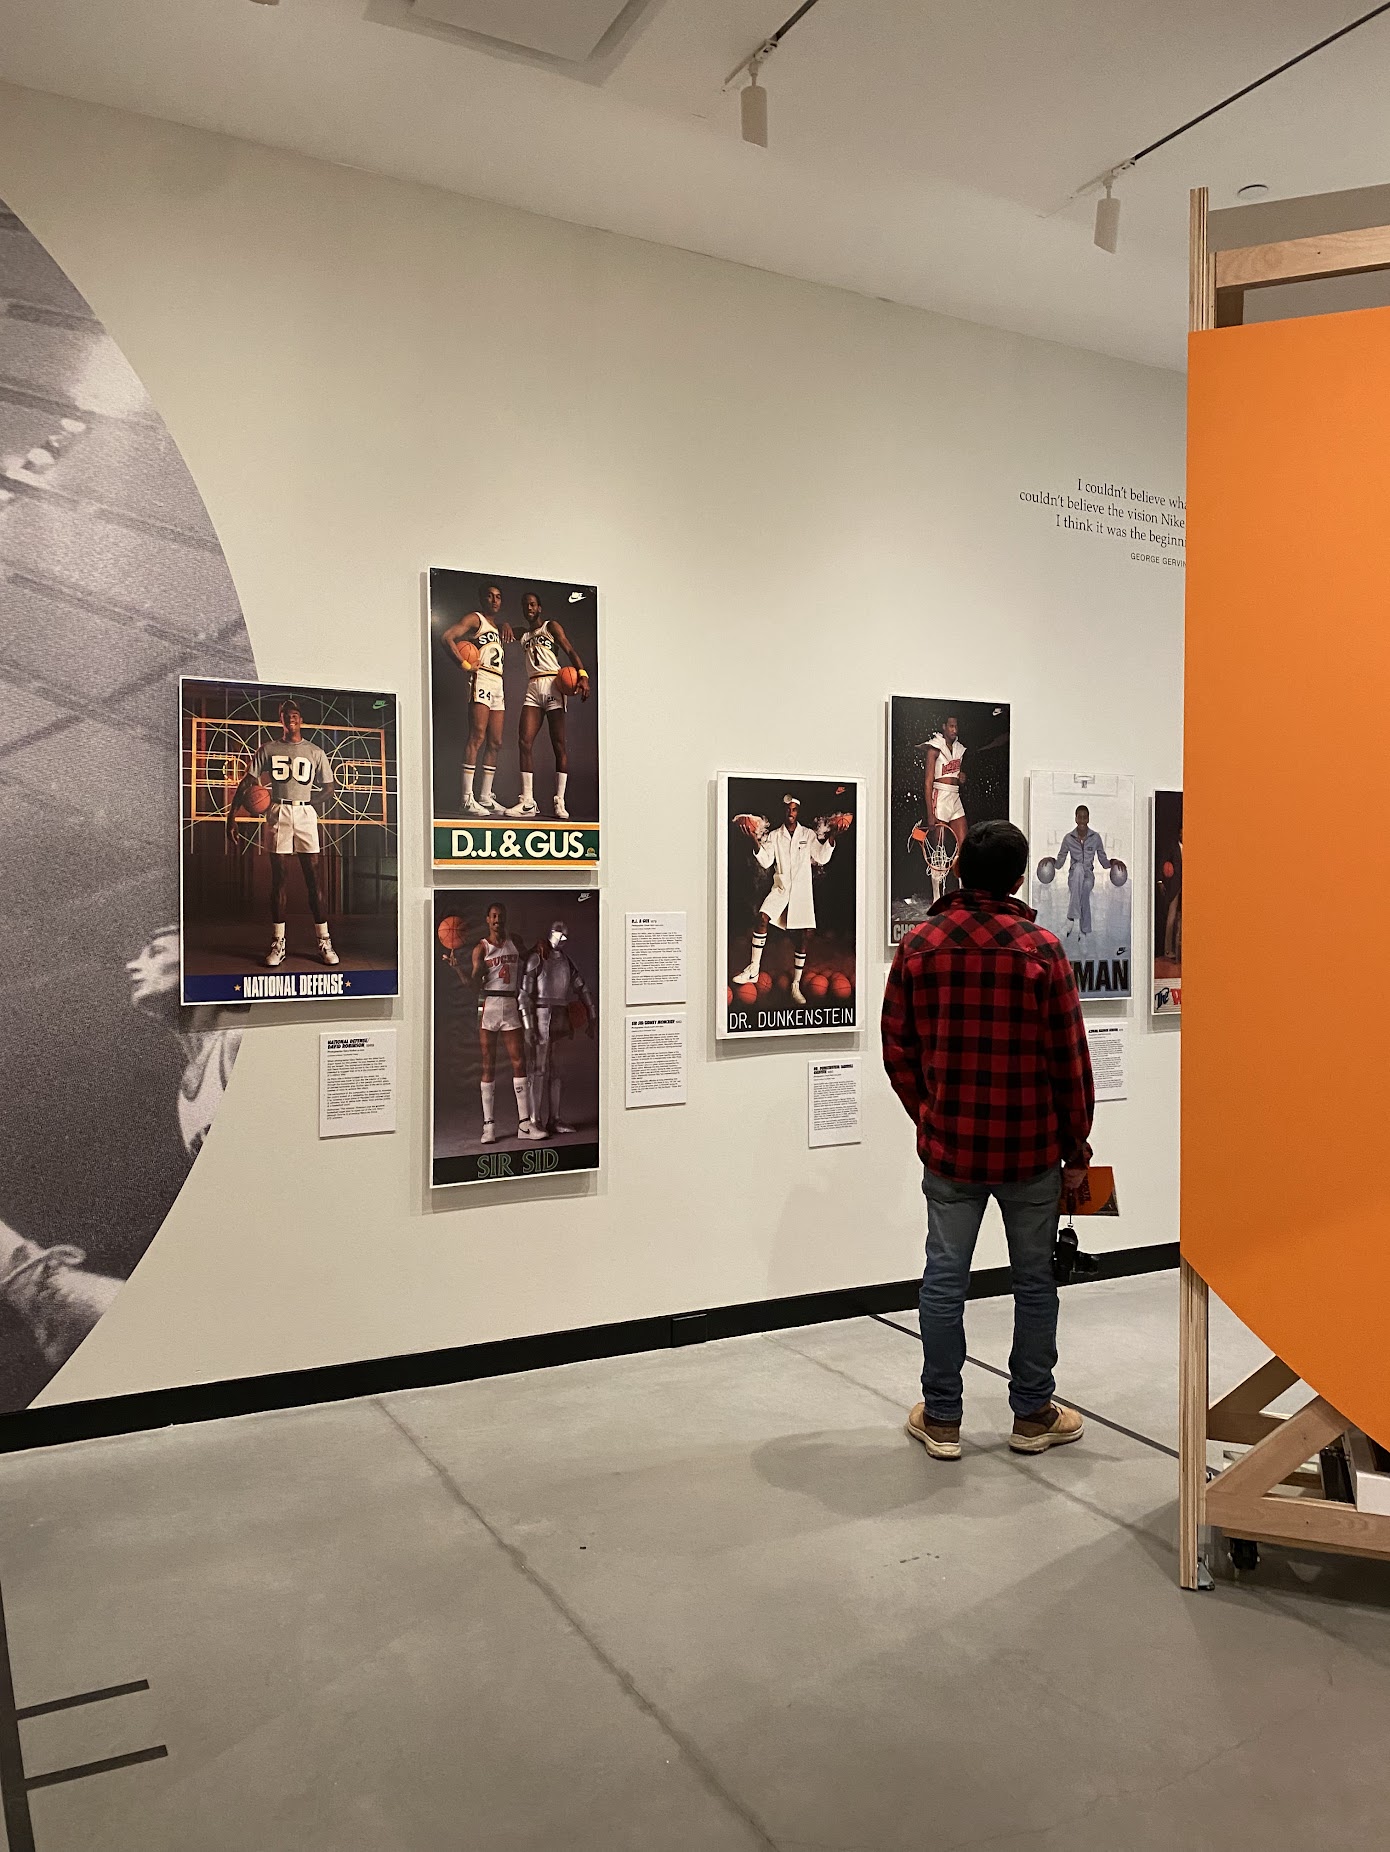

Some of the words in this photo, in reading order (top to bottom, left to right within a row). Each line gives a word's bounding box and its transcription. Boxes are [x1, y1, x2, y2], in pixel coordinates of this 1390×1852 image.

[1077, 478, 1082, 491] I
[1085, 483, 1128, 499] couldn't
[1130, 488, 1166, 506] believe
[1019, 491, 1064, 508] couldn't
[1067, 496, 1105, 514] believe
[1108, 503, 1124, 518] the
[1127, 509, 1158, 524] vision
[1160, 513, 1185, 529] Nike
[1056, 514, 1061, 527] I
[1063, 515, 1093, 532] think
[1096, 521, 1104, 534] it
[1107, 526, 1127, 538] was
[1130, 526, 1147, 541] the
[1130, 552, 1160, 564] GEORGE
[478, 688, 491, 700] 24
[271, 755, 313, 785] 50
[451, 829, 497, 858] D.J.
[498, 829, 523, 858] &
[524, 830, 585, 859] GUS
[243, 975, 298, 998] NATIONAL
[299, 974, 344, 996] DEFENSE
[498, 964, 510, 984] 4
[1068, 959, 1129, 993] MAN
[729, 1012, 752, 1030] DR.
[758, 1008, 854, 1028] DUNKENSTEIN
[477, 1153, 514, 1178] SIR
[522, 1149, 559, 1174] SID
